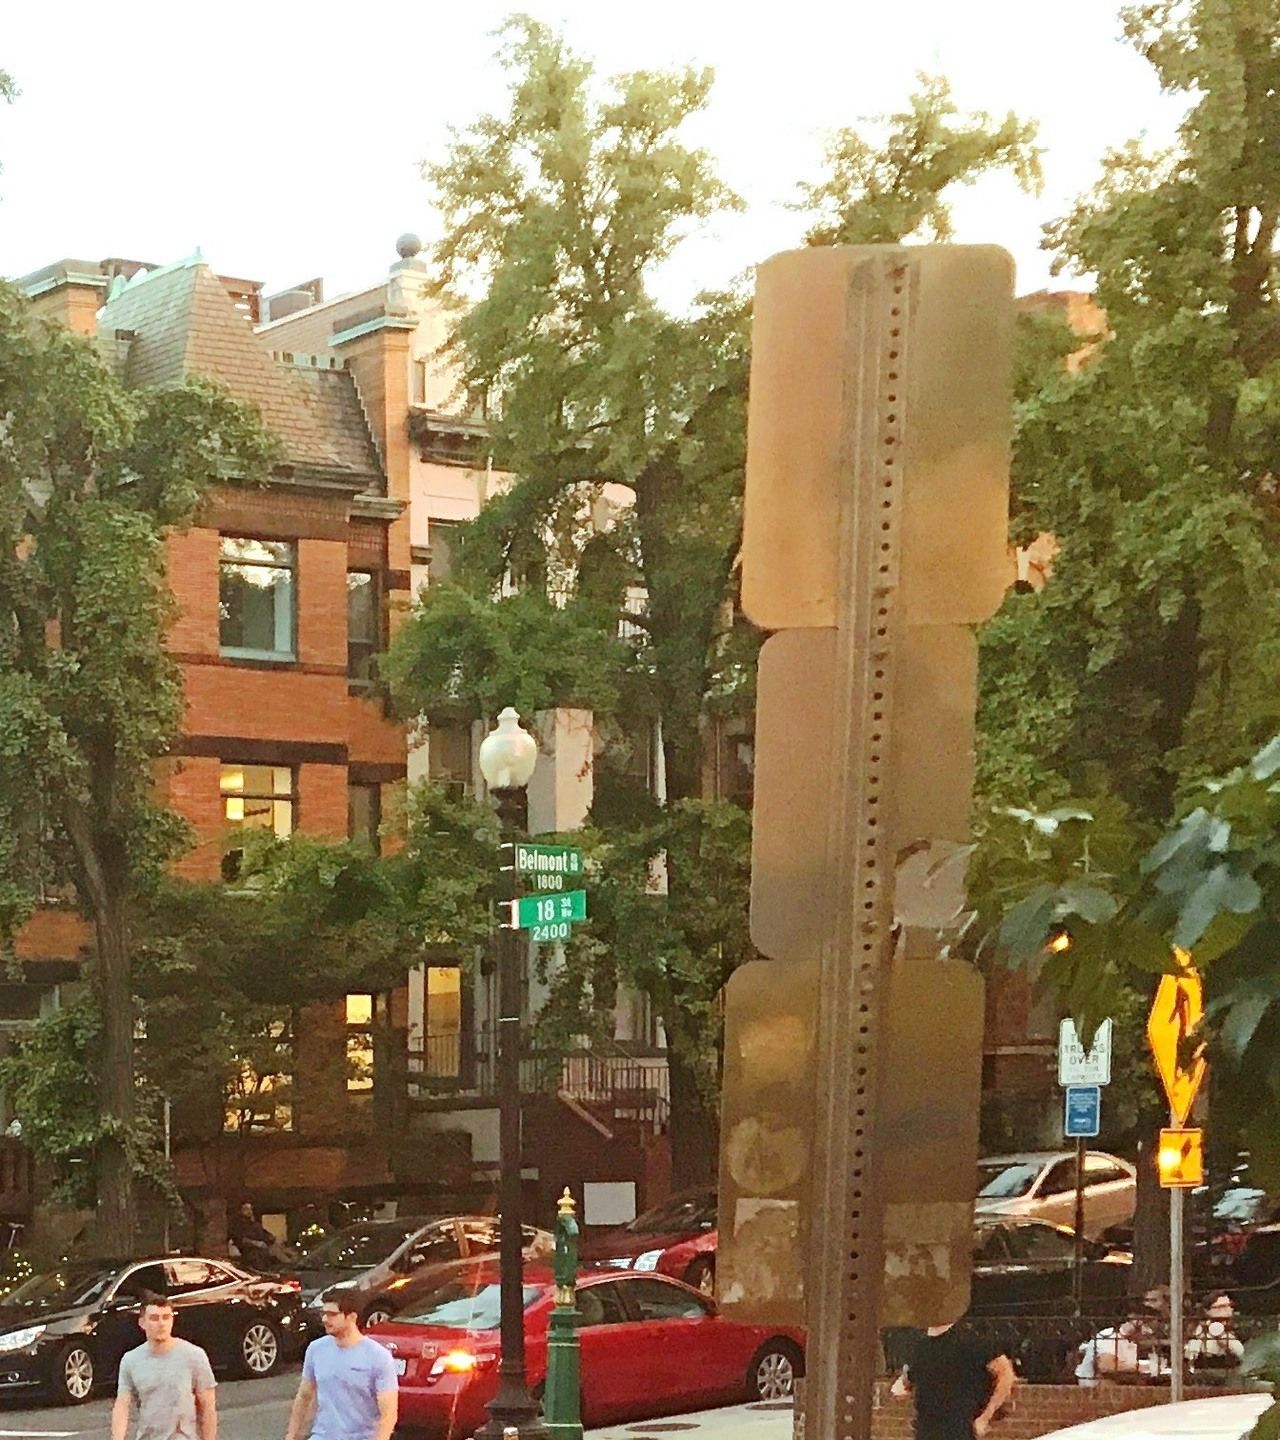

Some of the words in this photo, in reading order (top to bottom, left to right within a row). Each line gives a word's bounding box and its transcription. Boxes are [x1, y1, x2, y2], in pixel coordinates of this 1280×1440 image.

[519, 848, 568, 872] Belmont
[537, 874, 563, 890] 1800
[536, 899, 555, 921] 18
[533, 922, 568, 941] 2400
